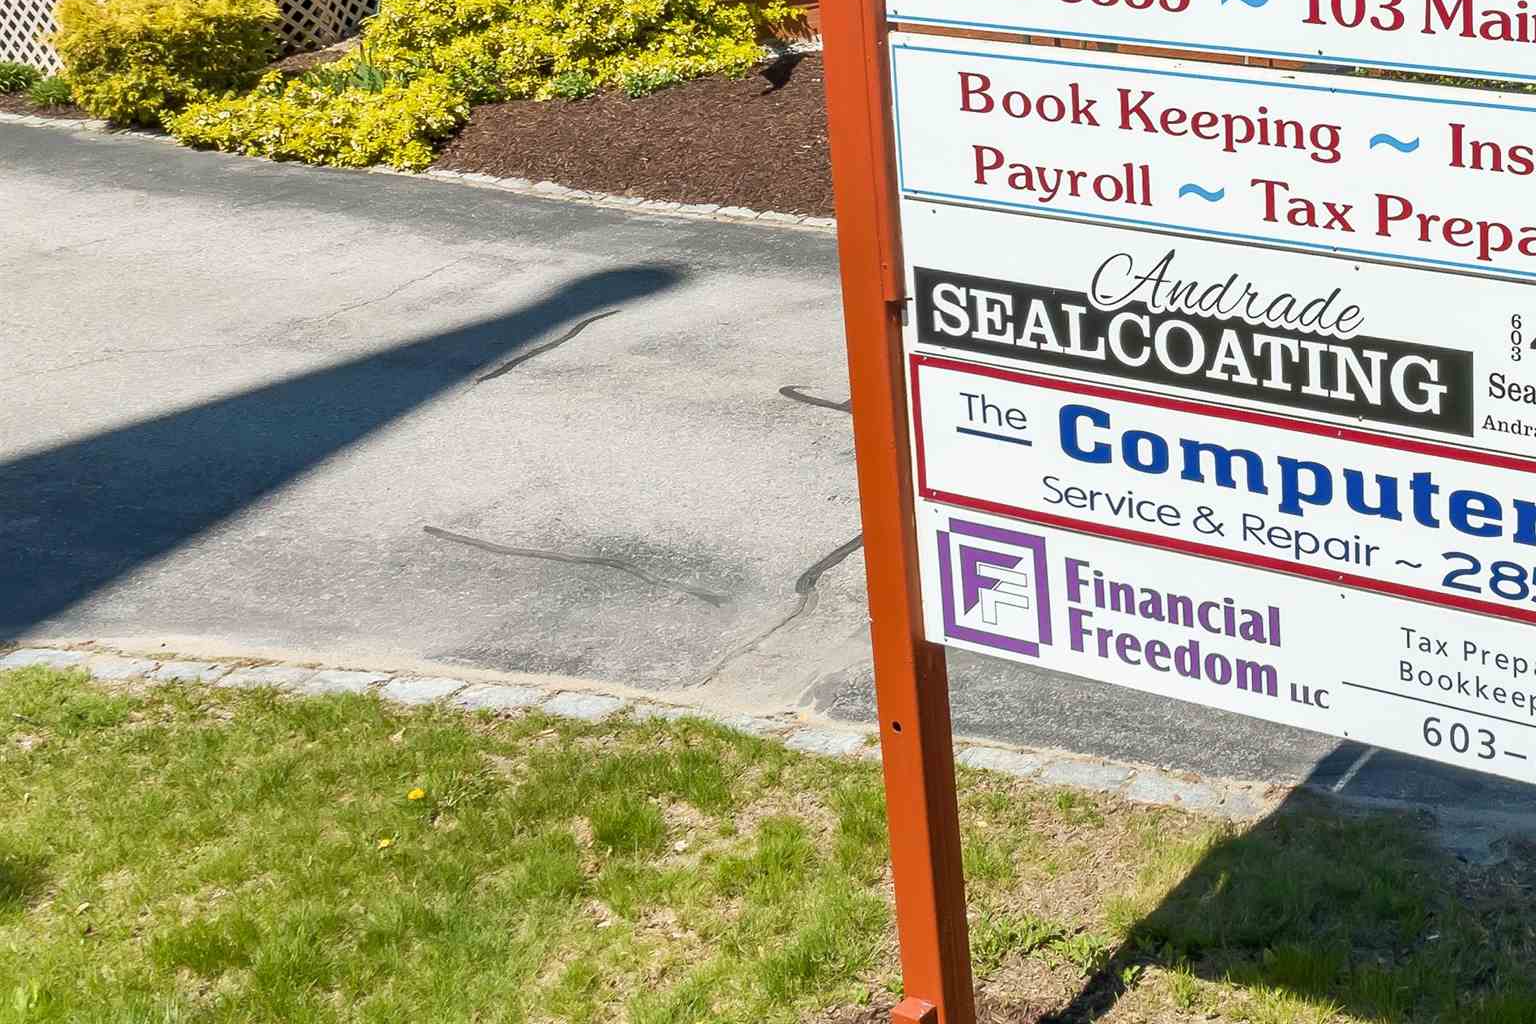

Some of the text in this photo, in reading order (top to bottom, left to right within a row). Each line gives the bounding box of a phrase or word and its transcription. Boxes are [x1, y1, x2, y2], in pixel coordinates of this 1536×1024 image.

[957, 72, 1100, 127] Book
[1117, 88, 1341, 164] Keeping
[972, 144, 1152, 206] Payroll
[1250, 178, 1356, 232] Tax
[1091, 249, 1366, 335] Andrade
[932, 283, 1447, 417] SEALCOATING
[960, 392, 1028, 431] The
[1042, 476, 1181, 527] Service
[1193, 506, 1224, 537] &
[1242, 513, 1380, 567] Repair
[1064, 557, 1281, 647] Financial
[1401, 628, 1448, 657] Tax
[1067, 607, 1330, 709] Freedom LLC
